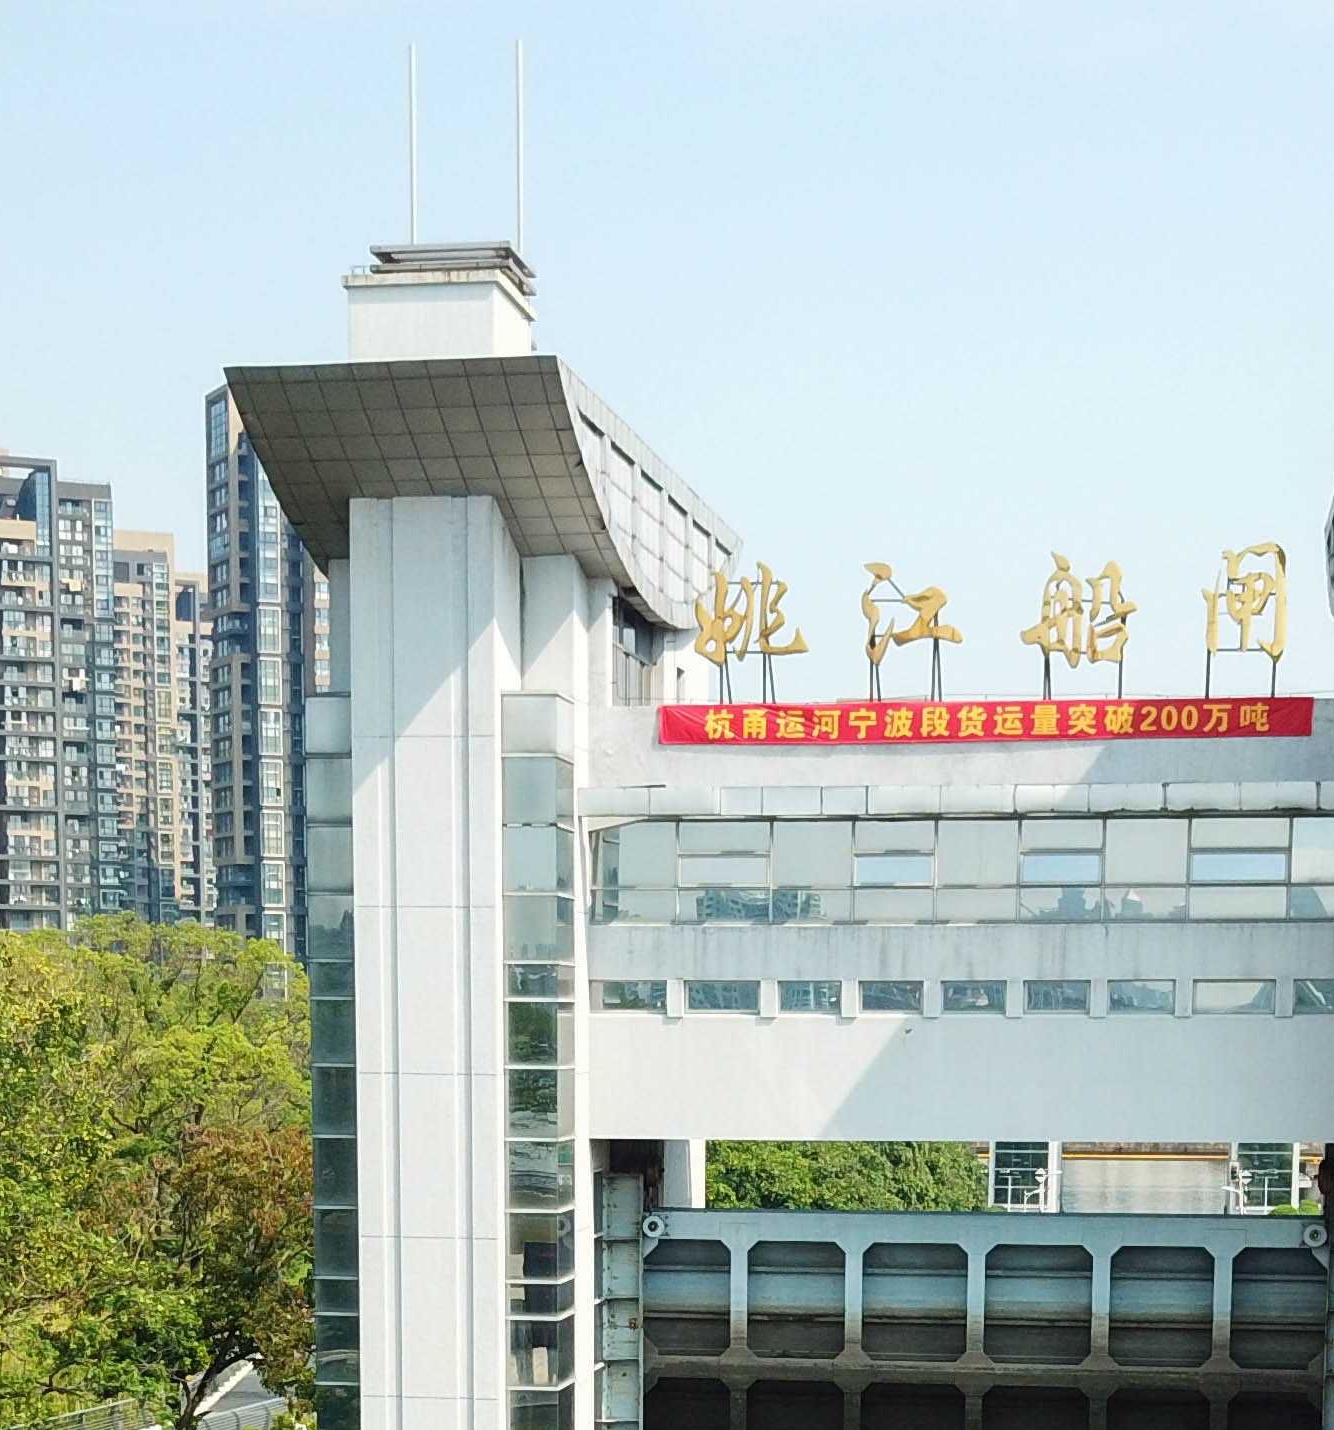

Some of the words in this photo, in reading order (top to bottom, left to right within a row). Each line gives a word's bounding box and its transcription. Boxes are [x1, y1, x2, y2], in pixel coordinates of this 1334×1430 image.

[704, 701, 1270, 741] 杭甬运河宁波段货运量突破200万吨
